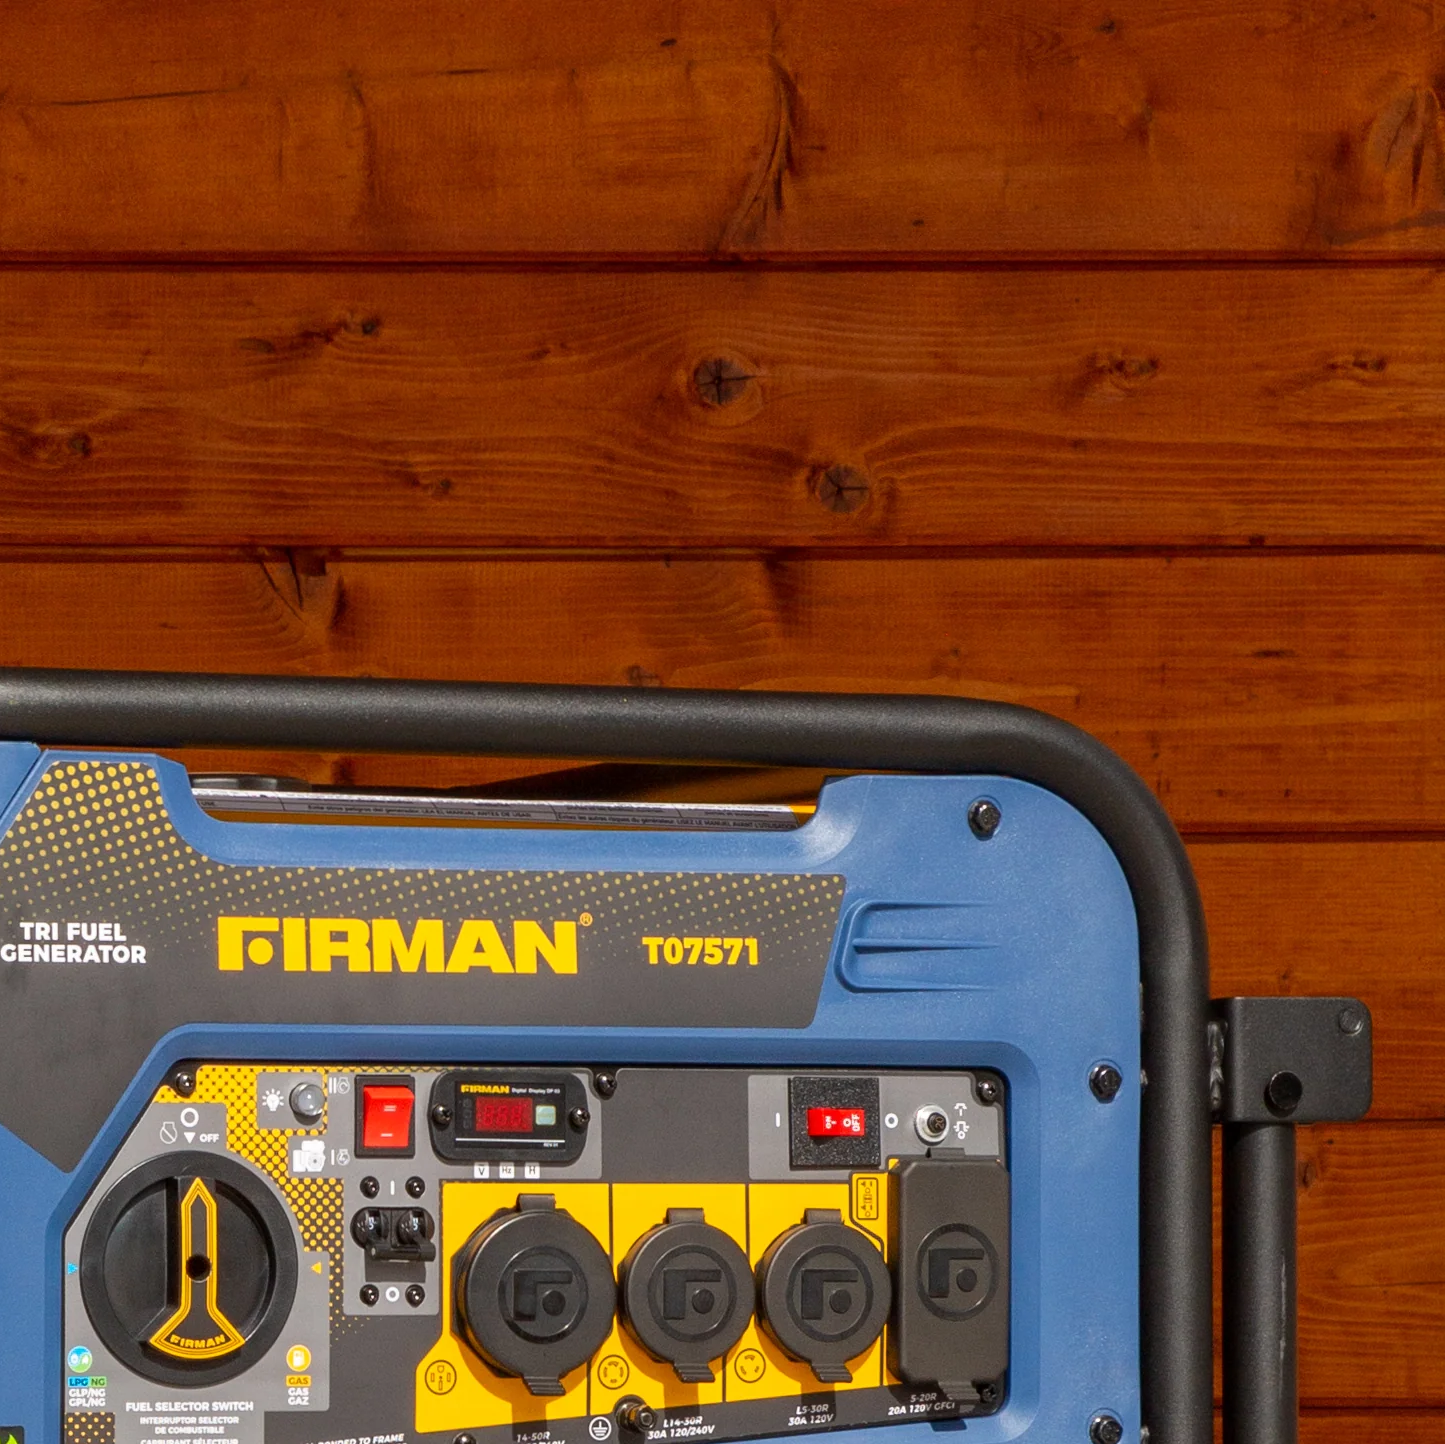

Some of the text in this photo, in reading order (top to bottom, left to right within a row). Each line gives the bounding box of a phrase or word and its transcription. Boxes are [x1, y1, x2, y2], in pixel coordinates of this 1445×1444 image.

[19, 922, 127, 941] TRI FUEL
[0, 944, 146, 963] GENERATOR
[641, 937, 759, 966] T07571
[461, 1085, 509, 1093] FIRMAN
[199, 1133, 220, 1142] OFF
[170, 1334, 226, 1348] FIRMAN
[69, 1378, 105, 1386] LPG NG
[288, 1377, 309, 1385] GAS
[69, 1389, 105, 1398] GLP/NG
[288, 1388, 309, 1396] GAS
[69, 1398, 105, 1407] GPL/NG
[288, 1397, 309, 1406] GAZ
[126, 1401, 254, 1412] FUEL SELECTOR SWITCH
[888, 1405, 906, 1415] 20A
[910, 1403, 932, 1413] 120V
[199, 1416, 239, 1424] SELECTOR
[788, 1414, 834, 1427] 30A 120V
[168, 1426, 224, 1434] COMBUSTIBLE
[647, 1425, 715, 1440] 30A 120/240V
[359, 1437, 371, 1444] TO
[373, 1433, 405, 1444] FRAME
